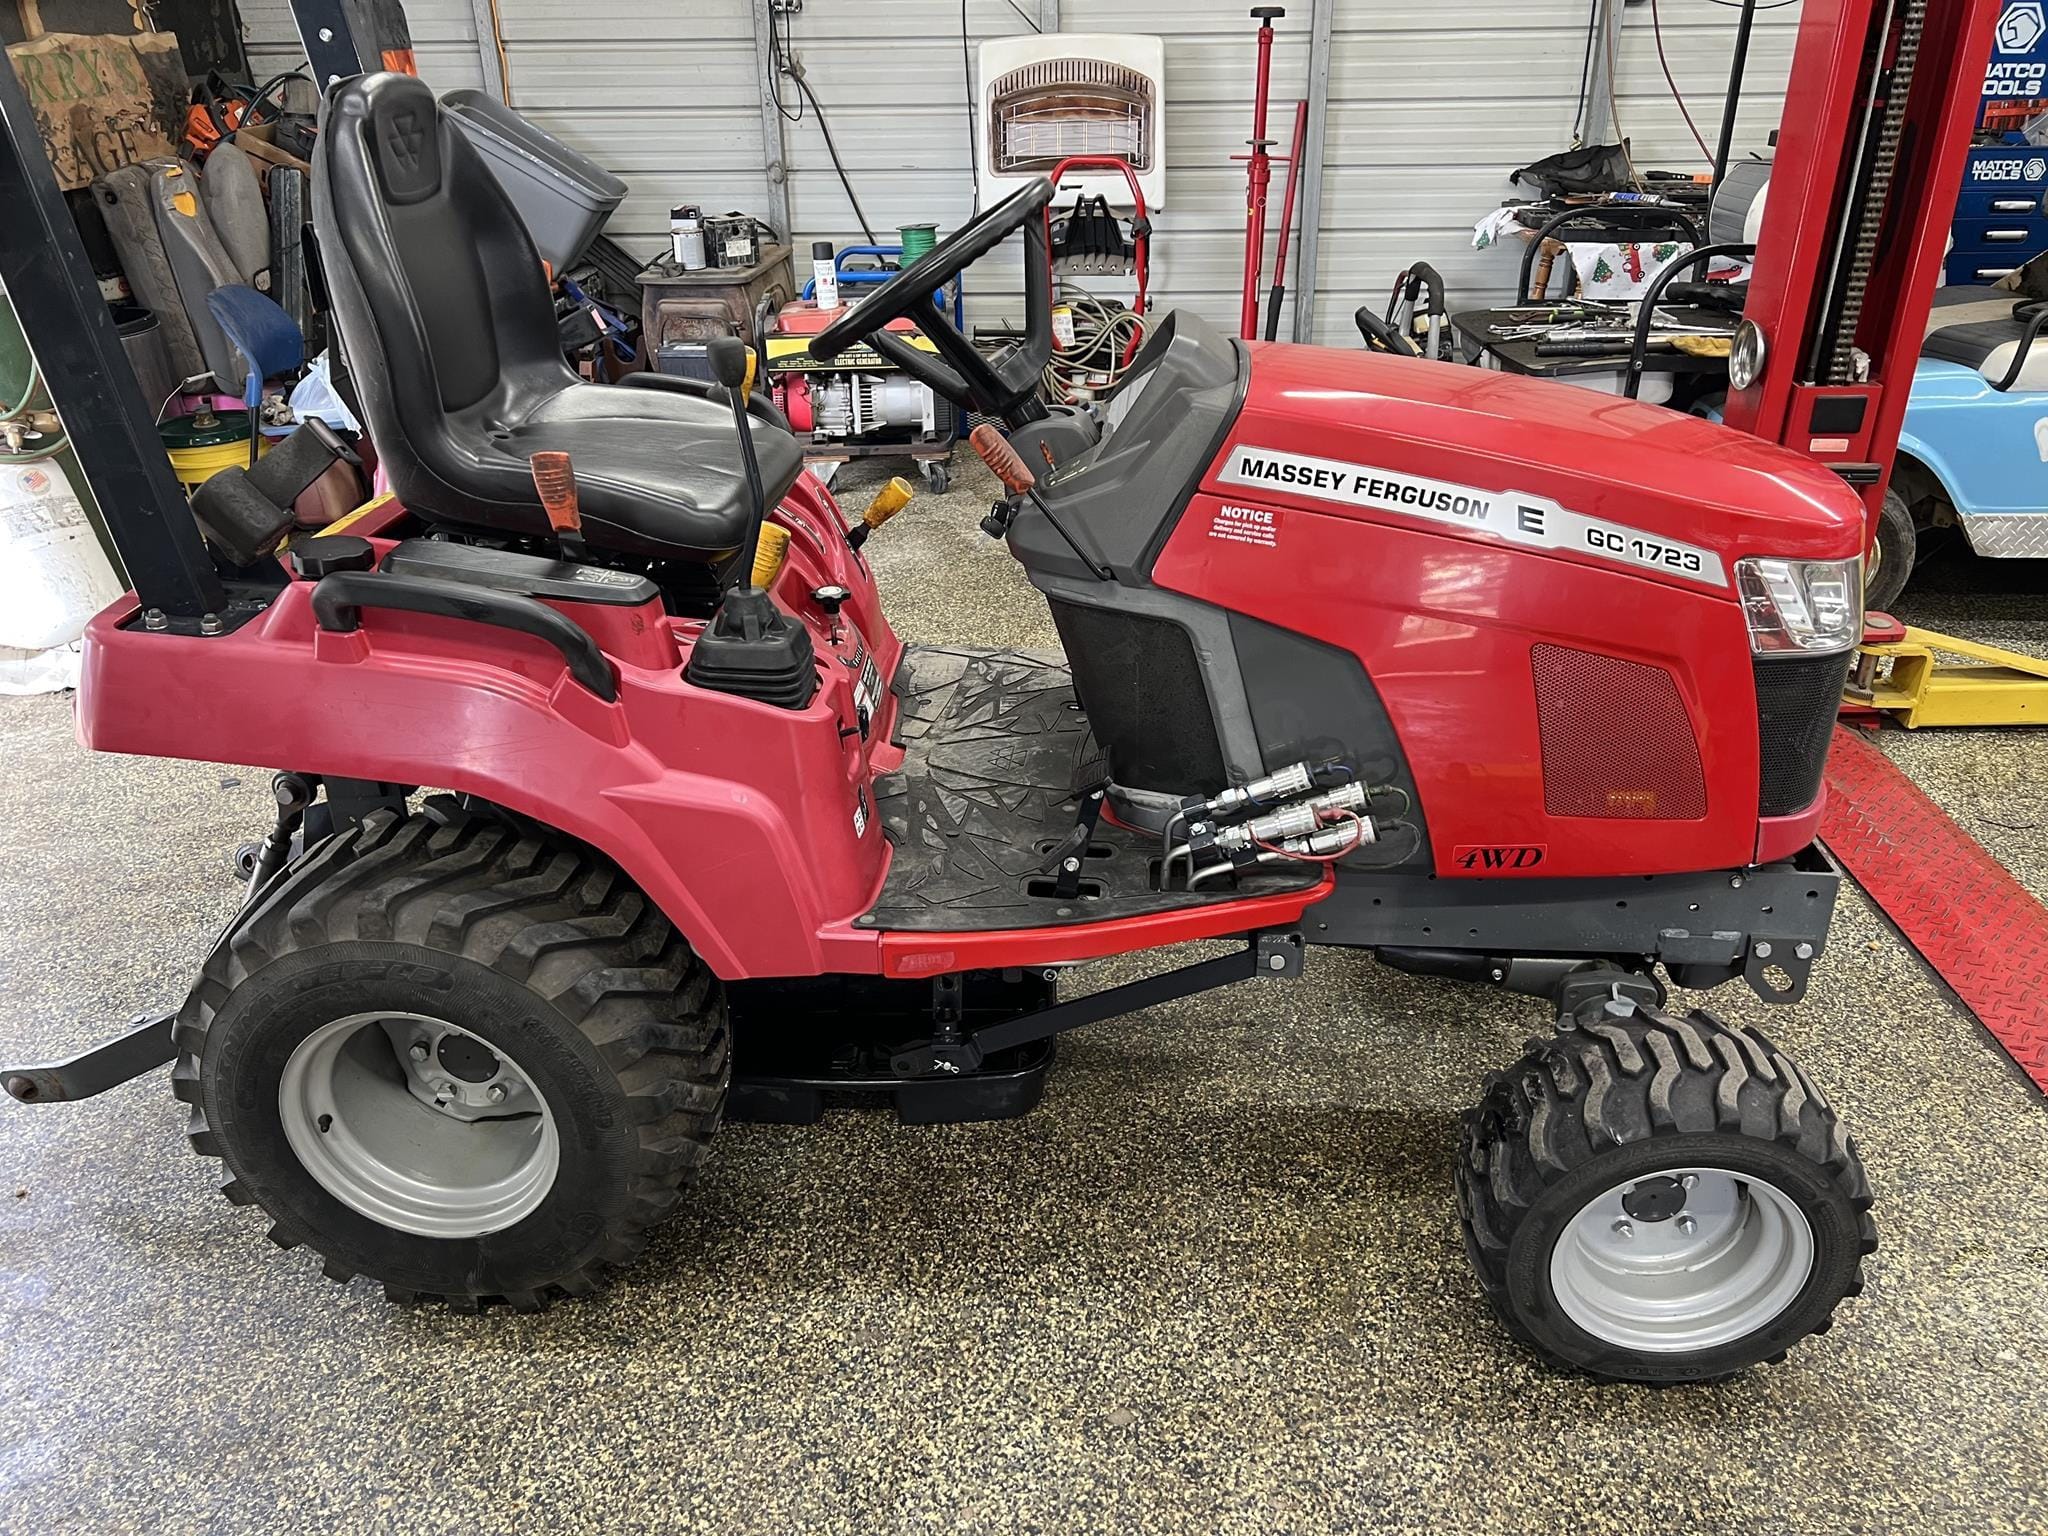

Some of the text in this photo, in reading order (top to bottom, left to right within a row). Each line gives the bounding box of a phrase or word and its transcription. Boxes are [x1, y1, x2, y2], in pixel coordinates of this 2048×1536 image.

[1981, 80, 2042, 96] OOLS
[43, 122, 141, 183] RAGE
[1972, 160, 2023, 170] MATCO
[1972, 170, 2022, 181] TOOLS
[834, 358, 856, 366] ELECTRIC
[1220, 505, 1274, 524] NOTICE
[1240, 458, 1701, 572] MASSEY FERGUSON E GC 1723
[1213, 518, 1234, 526] Charges
[1213, 524, 1233, 533] delivery
[1456, 847, 1543, 870] 4WD
